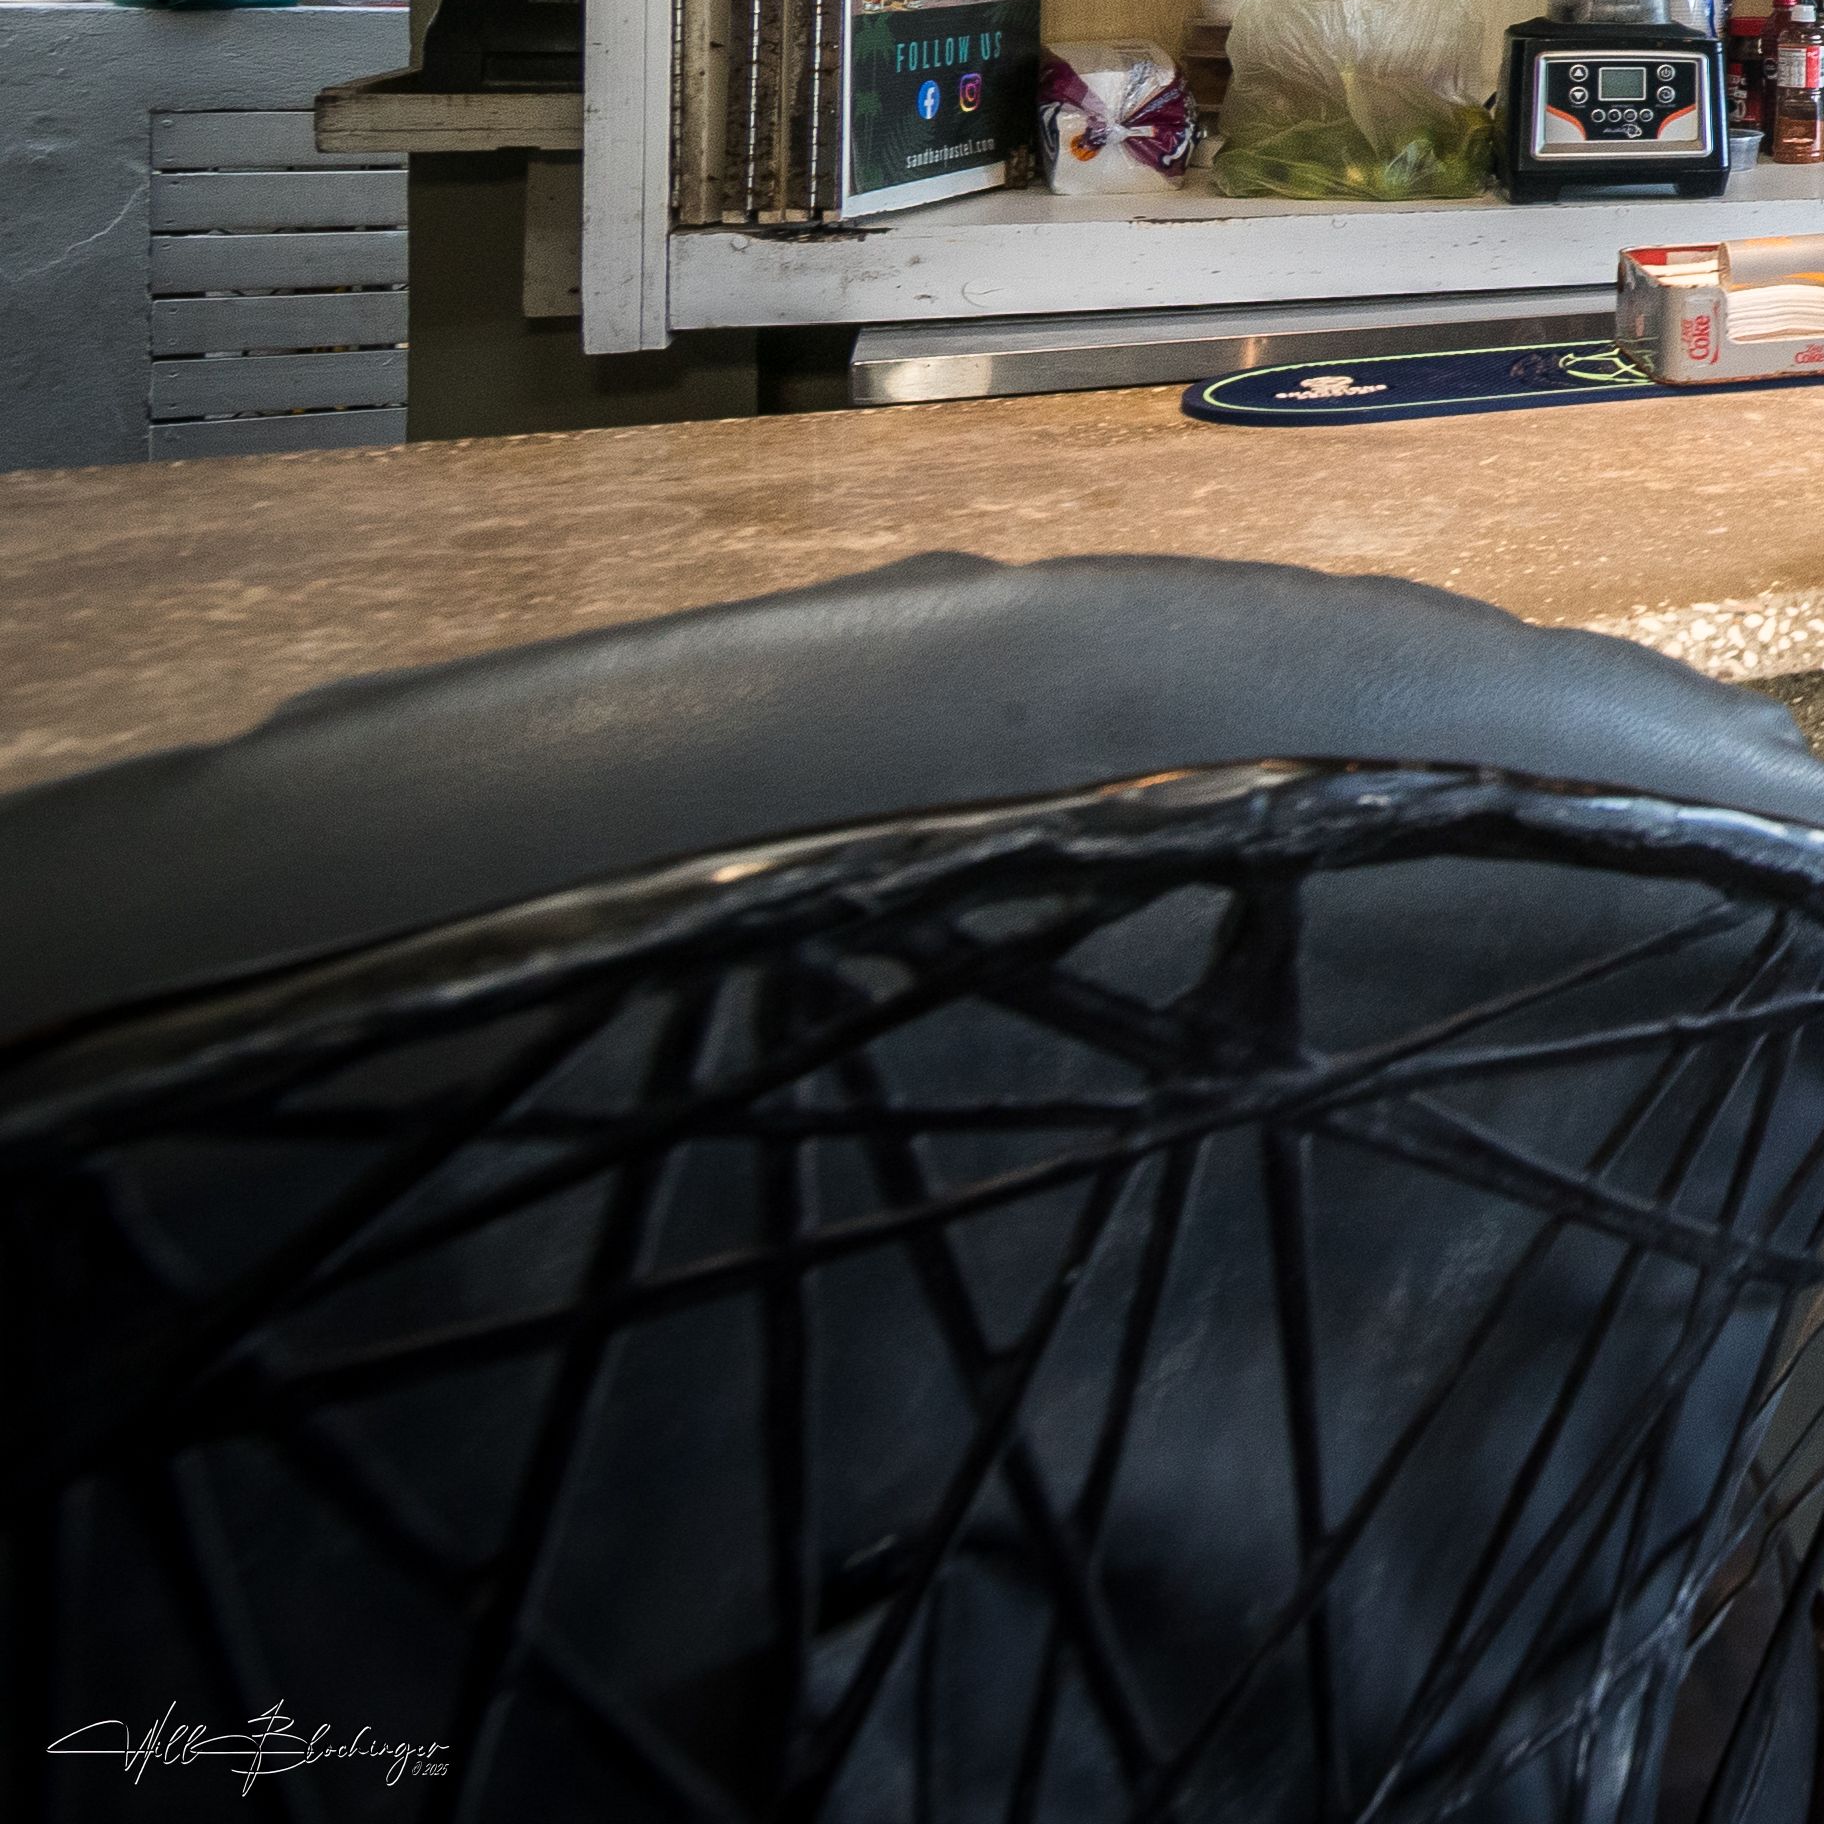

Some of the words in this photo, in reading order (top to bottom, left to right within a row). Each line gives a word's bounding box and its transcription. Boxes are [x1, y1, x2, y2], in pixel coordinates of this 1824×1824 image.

[896, 35, 970, 73] FOLLOW
[980, 31, 1003, 60] US
[906, 137, 995, 169] sandbarhostel.com
[1688, 314, 1711, 362] Coke
